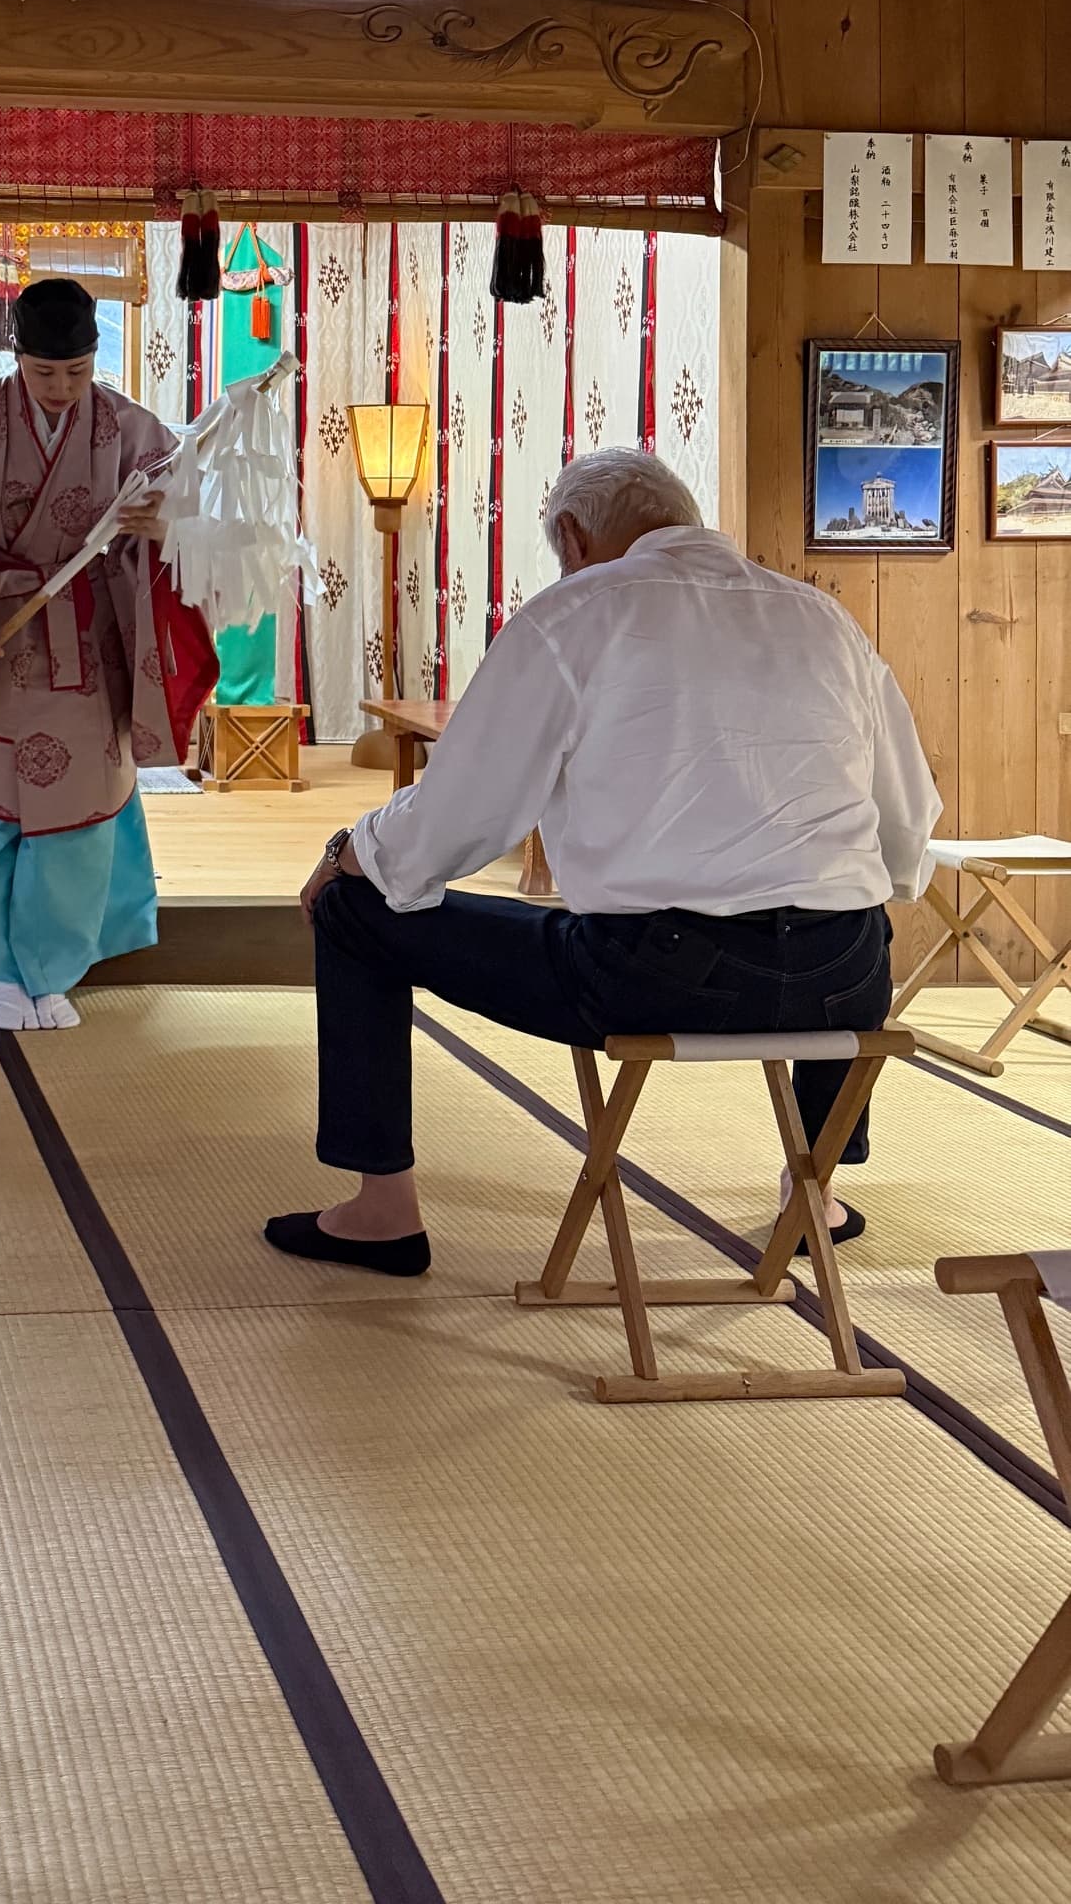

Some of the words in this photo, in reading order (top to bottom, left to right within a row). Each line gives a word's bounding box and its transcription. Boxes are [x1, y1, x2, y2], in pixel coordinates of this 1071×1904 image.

[866, 137, 877, 160] 奉納
[962, 141, 973, 163] 奉納
[1061, 145, 1071, 168] 奉納
[881, 165, 891, 187] 酒粕
[980, 174, 989, 195] 菓子
[1044, 180, 1055, 267] 有限会社浅川建工
